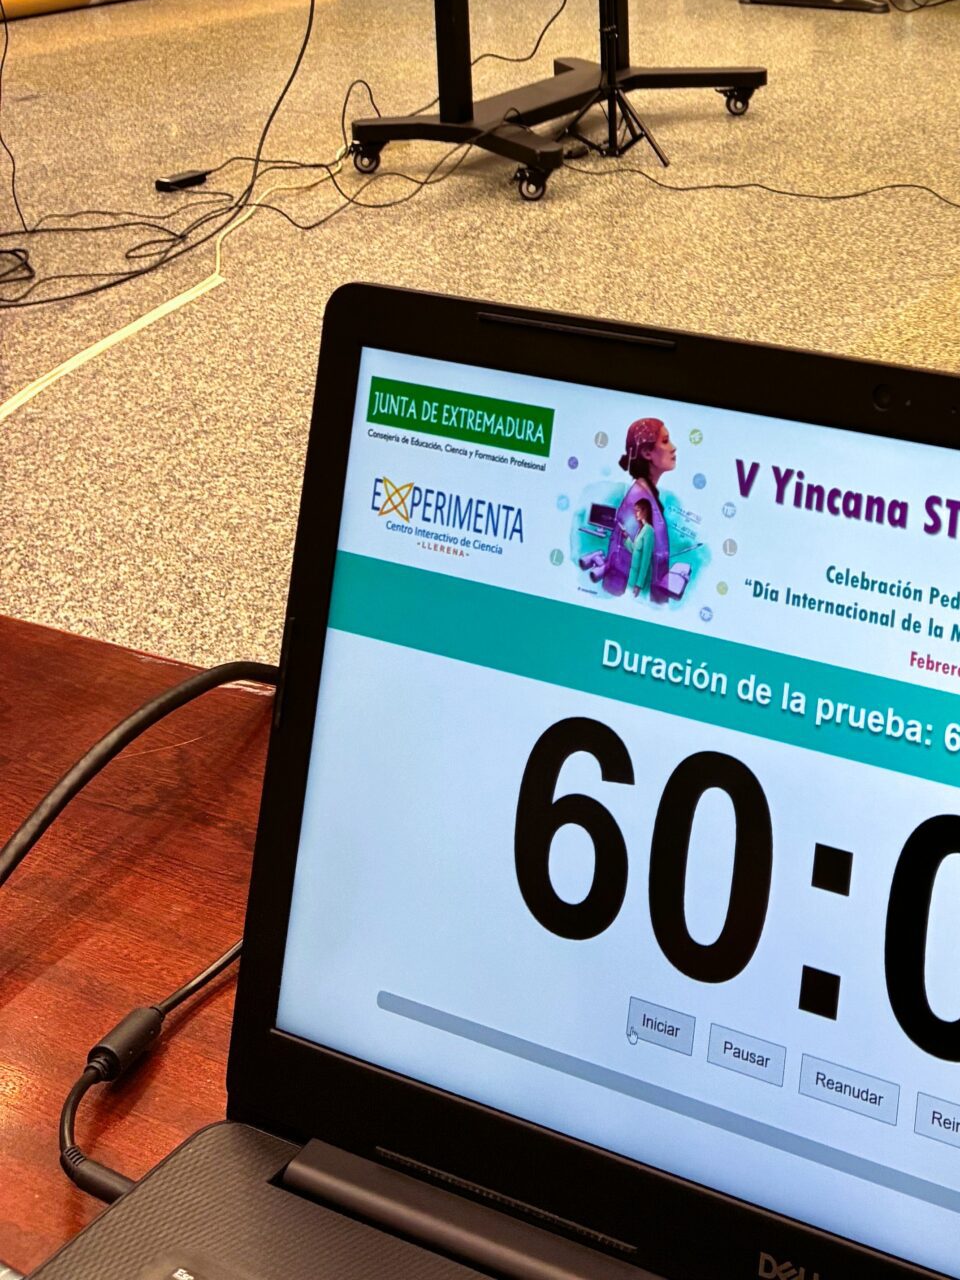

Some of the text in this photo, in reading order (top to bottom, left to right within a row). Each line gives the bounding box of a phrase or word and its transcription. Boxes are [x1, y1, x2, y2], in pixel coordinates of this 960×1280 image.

[372, 392, 545, 444] JUNTA DE EXTREMADURA
[368, 429, 546, 471] Consejería de Educación, Ciencia y Formación Profesional
[371, 476, 524, 543] EXPERIMENTA
[735, 458, 760, 498] V
[772, 465, 909, 529] Yincana
[386, 520, 503, 555] Centro Interactivo de Ciencia
[826, 565, 923, 602] Celebración
[786, 587, 896, 628] Internacional
[901, 613, 922, 634] de
[928, 618, 944, 638] la
[602, 639, 728, 695] Duración
[737, 674, 772, 705] de
[781, 682, 806, 714] la
[815, 696, 933, 746] prueba:
[642, 1013, 680, 1038] Iniciar
[723, 1041, 770, 1070] Pausar
[815, 1072, 884, 1107] Reanudar
